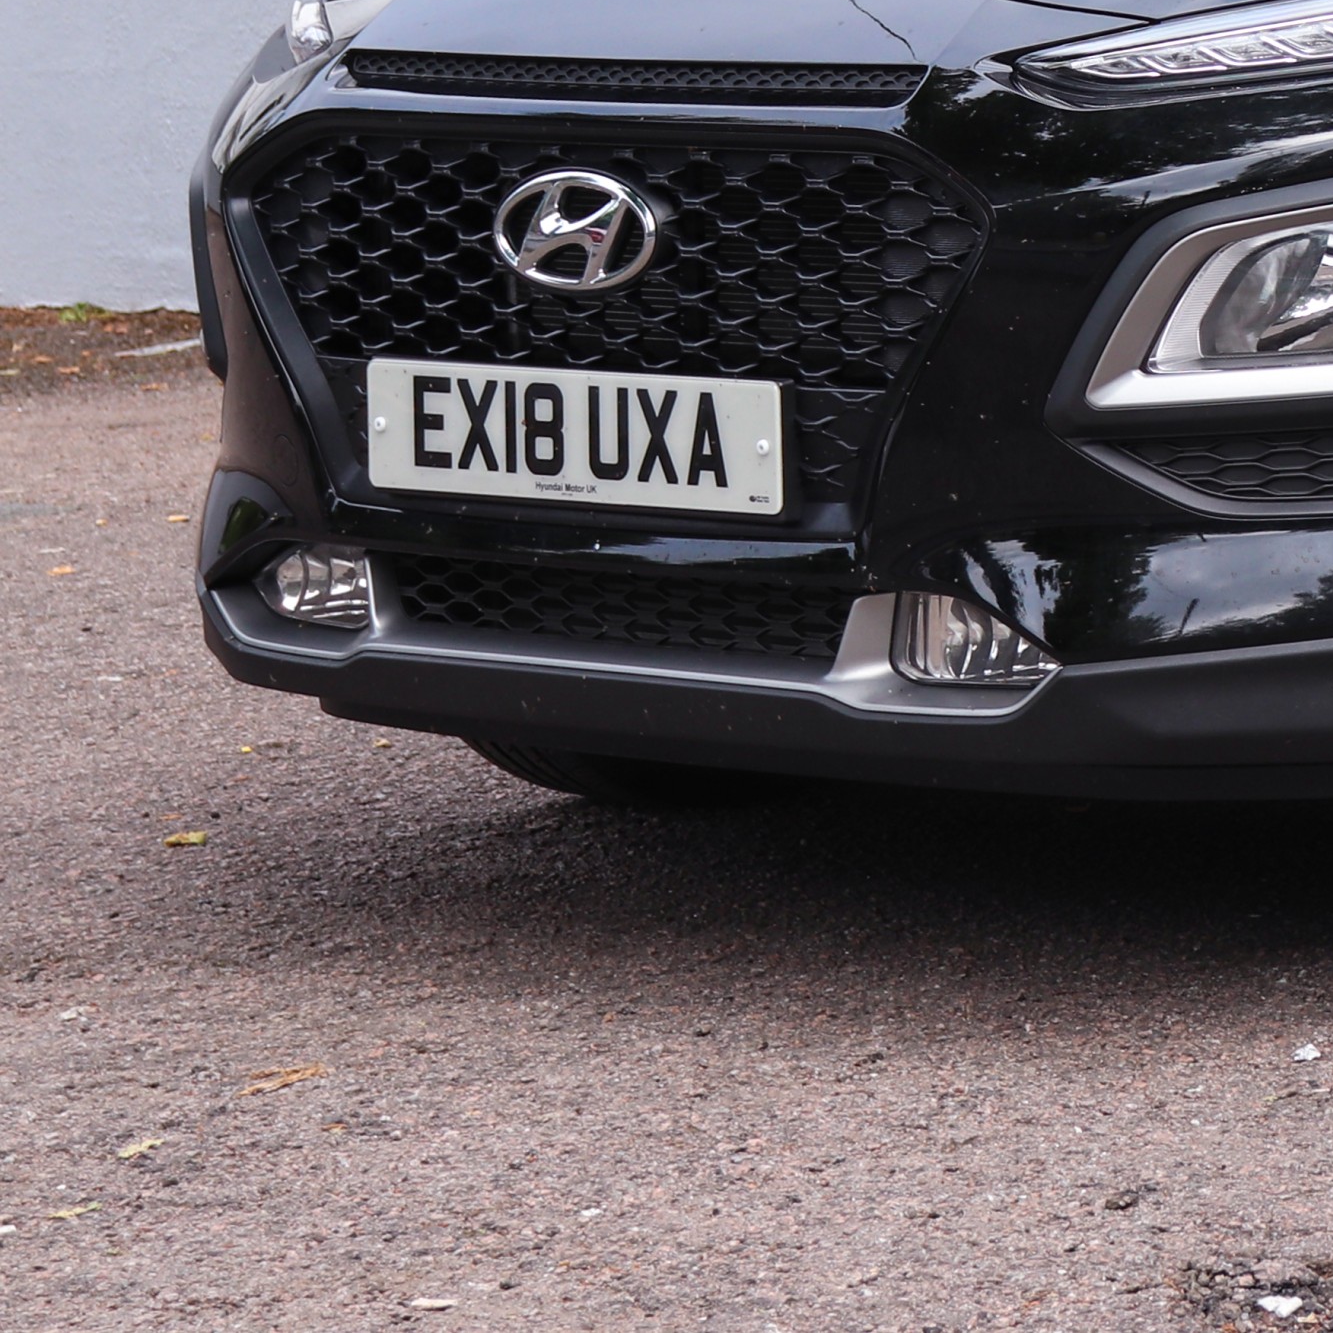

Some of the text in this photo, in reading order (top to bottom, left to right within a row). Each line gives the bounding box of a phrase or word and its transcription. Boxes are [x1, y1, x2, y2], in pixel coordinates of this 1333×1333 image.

[413, 375, 729, 488] EX18 UXA
[535, 481, 598, 494] Hyundai Motor UK
